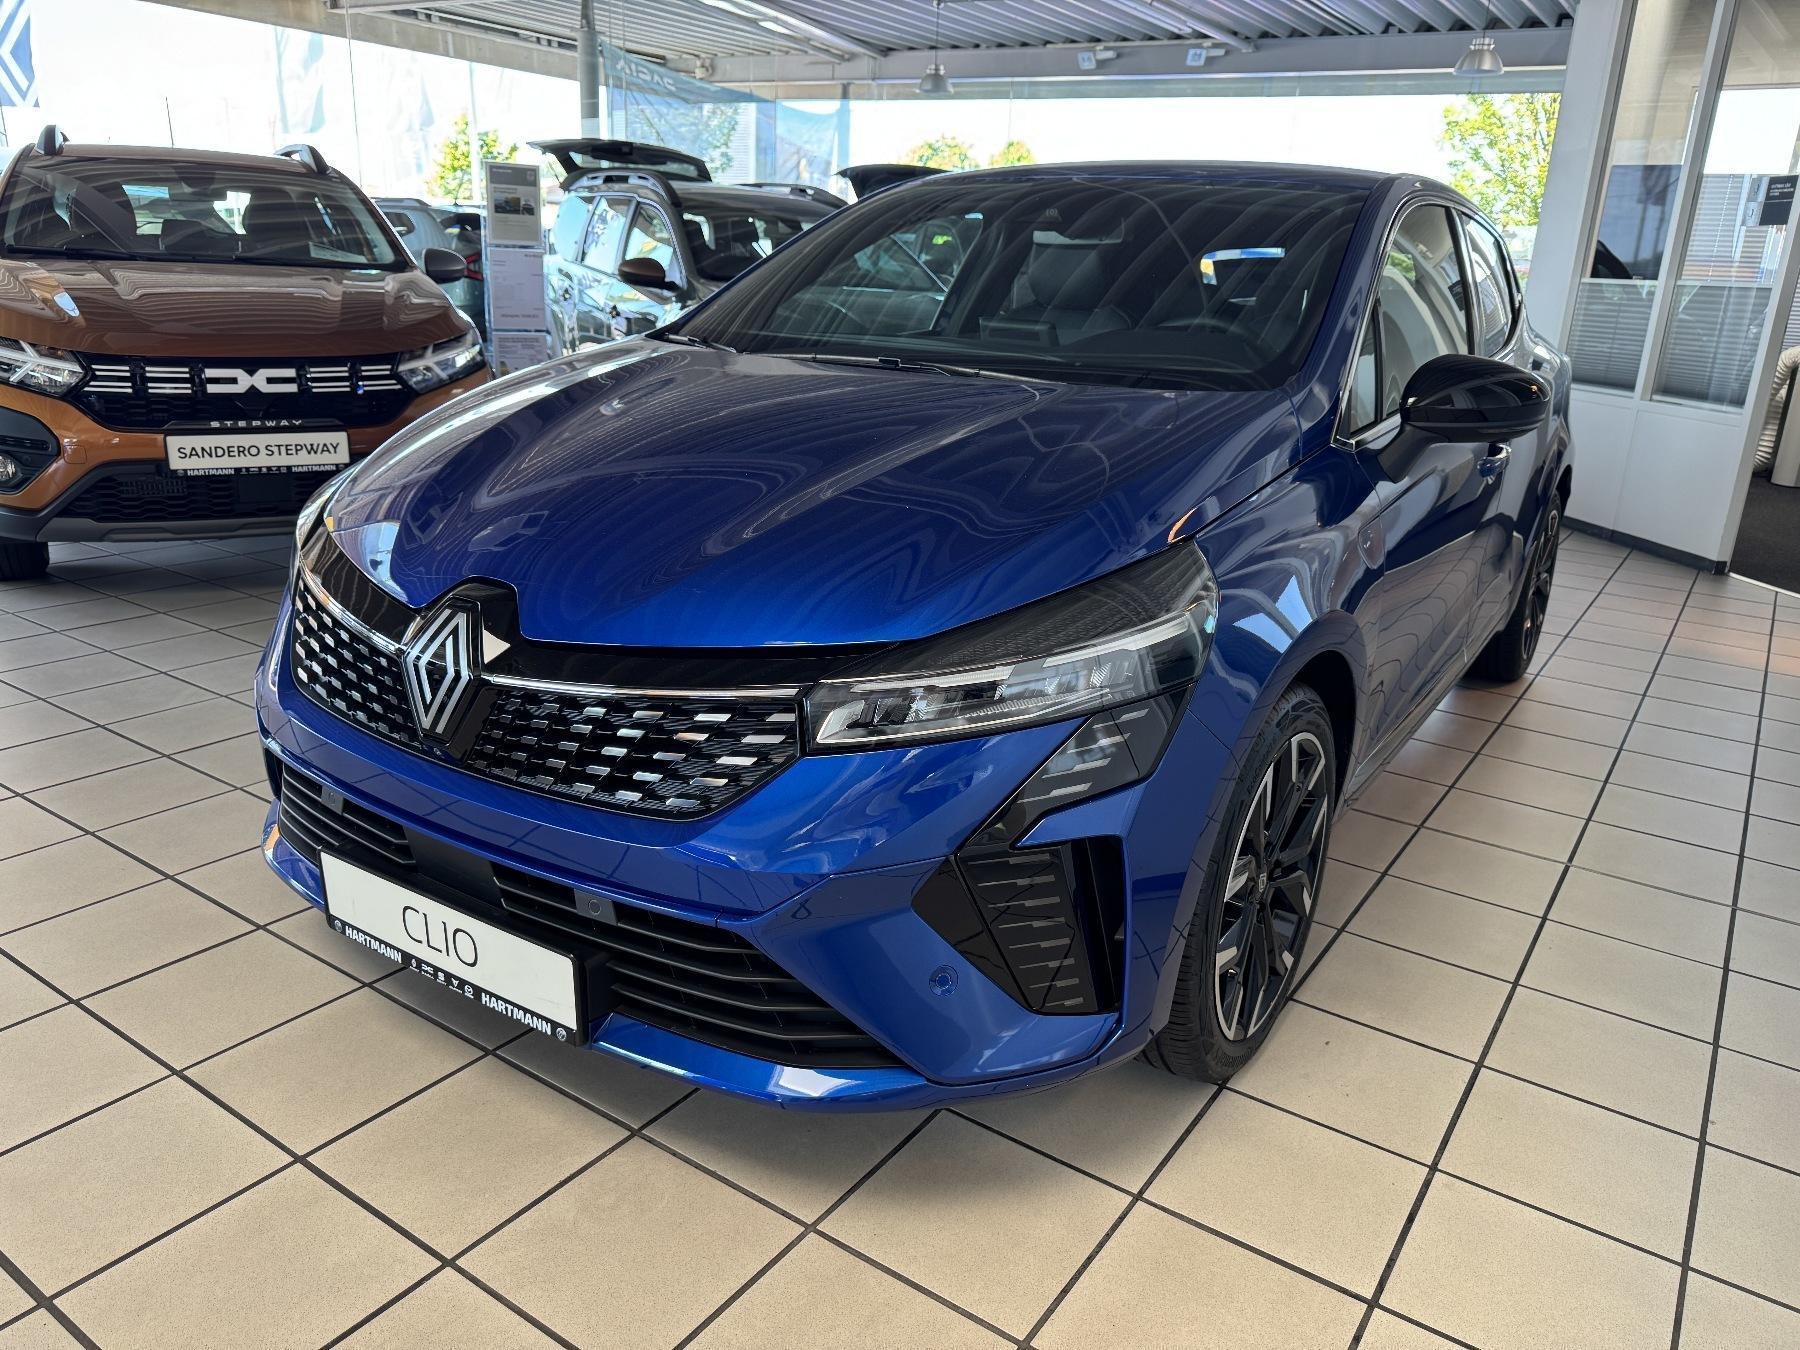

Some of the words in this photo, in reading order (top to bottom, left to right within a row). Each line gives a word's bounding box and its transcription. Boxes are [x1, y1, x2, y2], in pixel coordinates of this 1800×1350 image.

[210, 419, 302, 428] STEPWAY
[177, 445, 260, 459] SANDERO
[265, 442, 340, 457] STEPWAY
[187, 468, 235, 476] HARTMANN
[291, 464, 336, 473] HARTMANN
[402, 905, 478, 967] CLIO
[345, 925, 402, 964] HARTMANN
[481, 992, 552, 1036] HARTMANN
